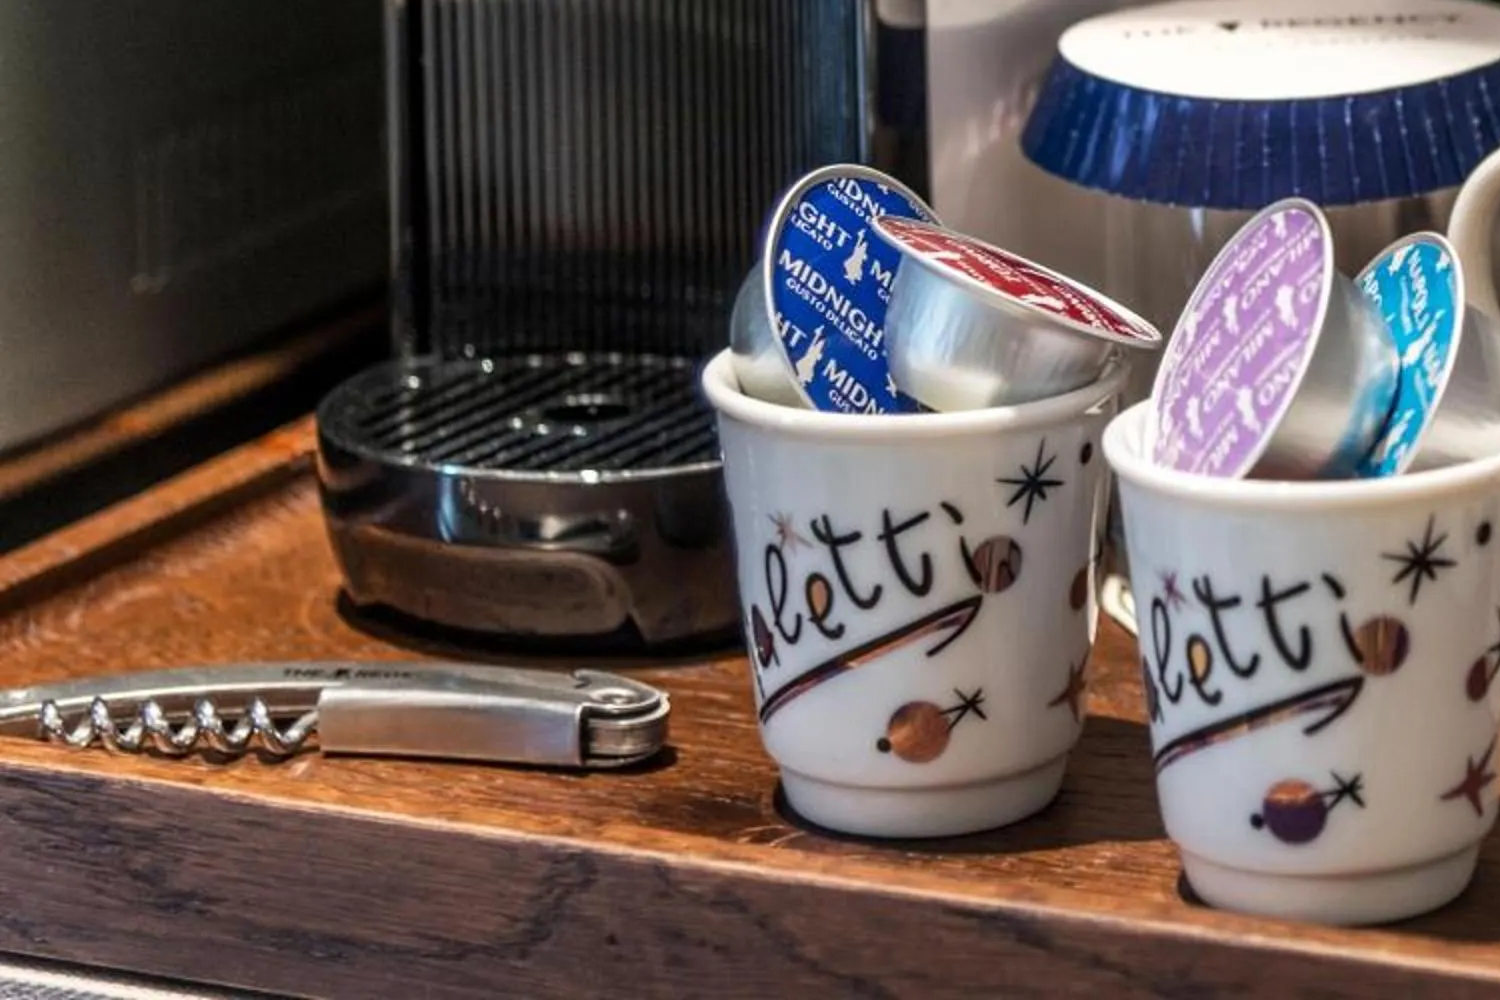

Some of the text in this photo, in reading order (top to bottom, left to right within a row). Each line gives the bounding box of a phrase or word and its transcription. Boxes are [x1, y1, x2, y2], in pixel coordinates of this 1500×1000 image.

[779, 249, 887, 356] MIDNIGH
[785, 277, 826, 313] GUSTO
[825, 308, 878, 361] DELICATO
